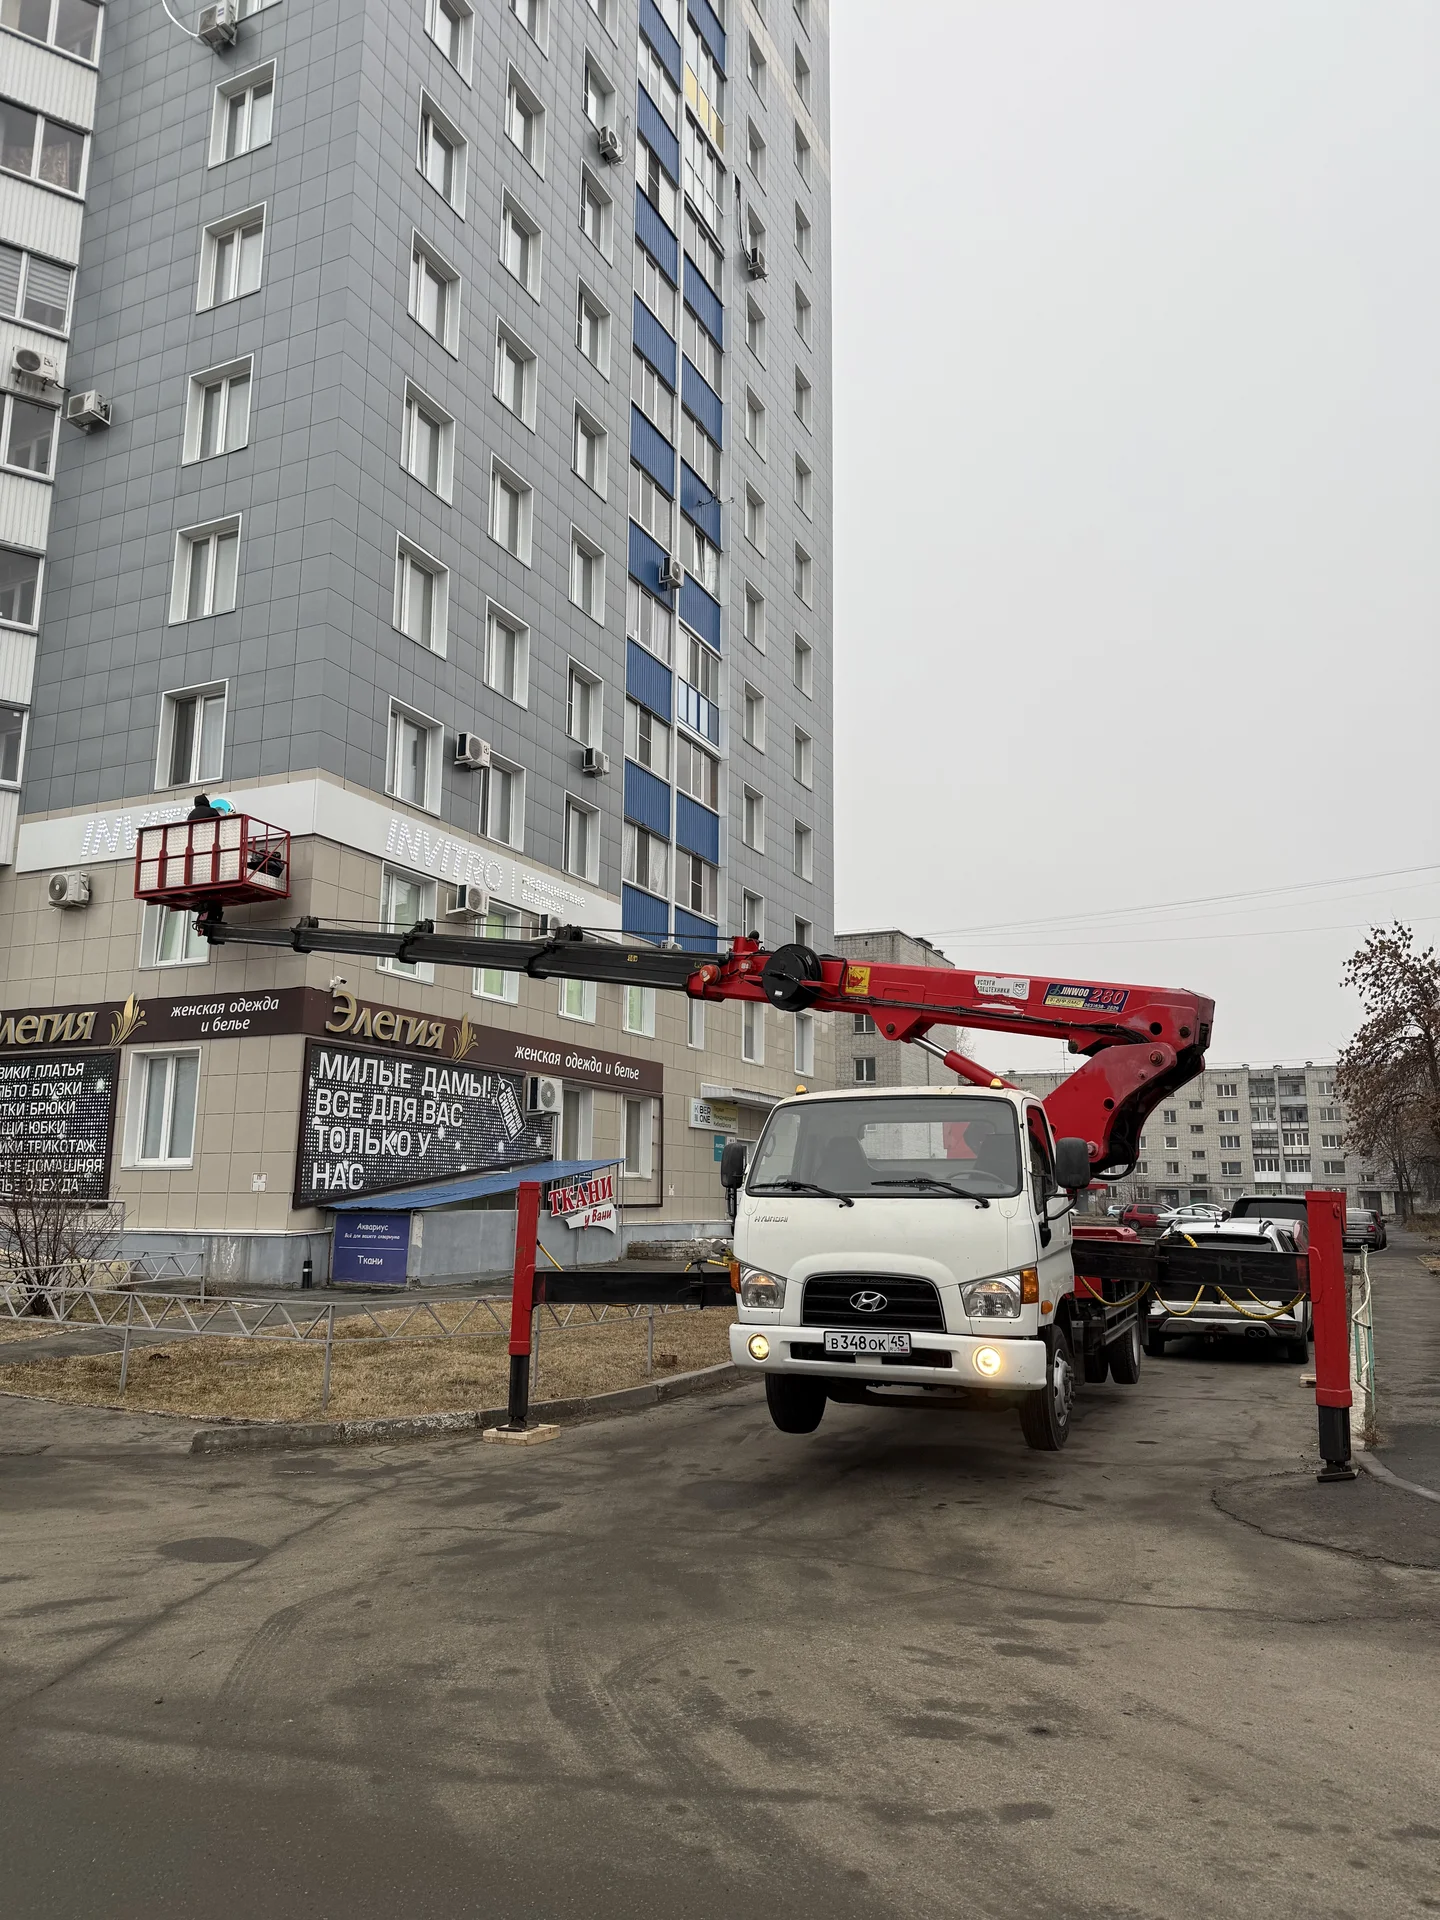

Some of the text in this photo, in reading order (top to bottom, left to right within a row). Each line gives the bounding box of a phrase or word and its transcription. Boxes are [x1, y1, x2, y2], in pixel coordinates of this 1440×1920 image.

[385, 818, 503, 892] INVITRO
[1061, 986, 1124, 1004] JINWOO 280
[171, 996, 279, 1017] женская одежда
[0, 1011, 98, 1045] легия
[201, 1017, 250, 1033] и белье
[326, 990, 447, 1049] Элегия
[35, 1062, 85, 1078] ПЛАТЬЯ
[514, 1045, 640, 1080] женская одежда и белье
[318, 1051, 492, 1099] МИЛЫЕ ДАМЫ!
[31, 1082, 82, 1097] БЛУЗКИ
[0, 1100, 76, 1116] ТКИ БРЮКИ
[315, 1088, 464, 1127] ВСЕ ДЛЯ ВАС
[498, 1092, 518, 1138] СКИДКИ
[28, 1119, 67, 1134] ЮБКИ
[28, 1138, 97, 1153] ТРИКОТАЖ
[314, 1124, 412, 1157] ТОЛЬКО
[26, 1159, 103, 1175] ДОМАШНЯЯ
[311, 1161, 364, 1190] НАС
[548, 1175, 615, 1217] ТКАНИ
[592, 1208, 612, 1223] Вани
[357, 1222, 388, 1232] Аквариус
[357, 1254, 383, 1266] Ткани
[890, 1335, 905, 1347] 45
